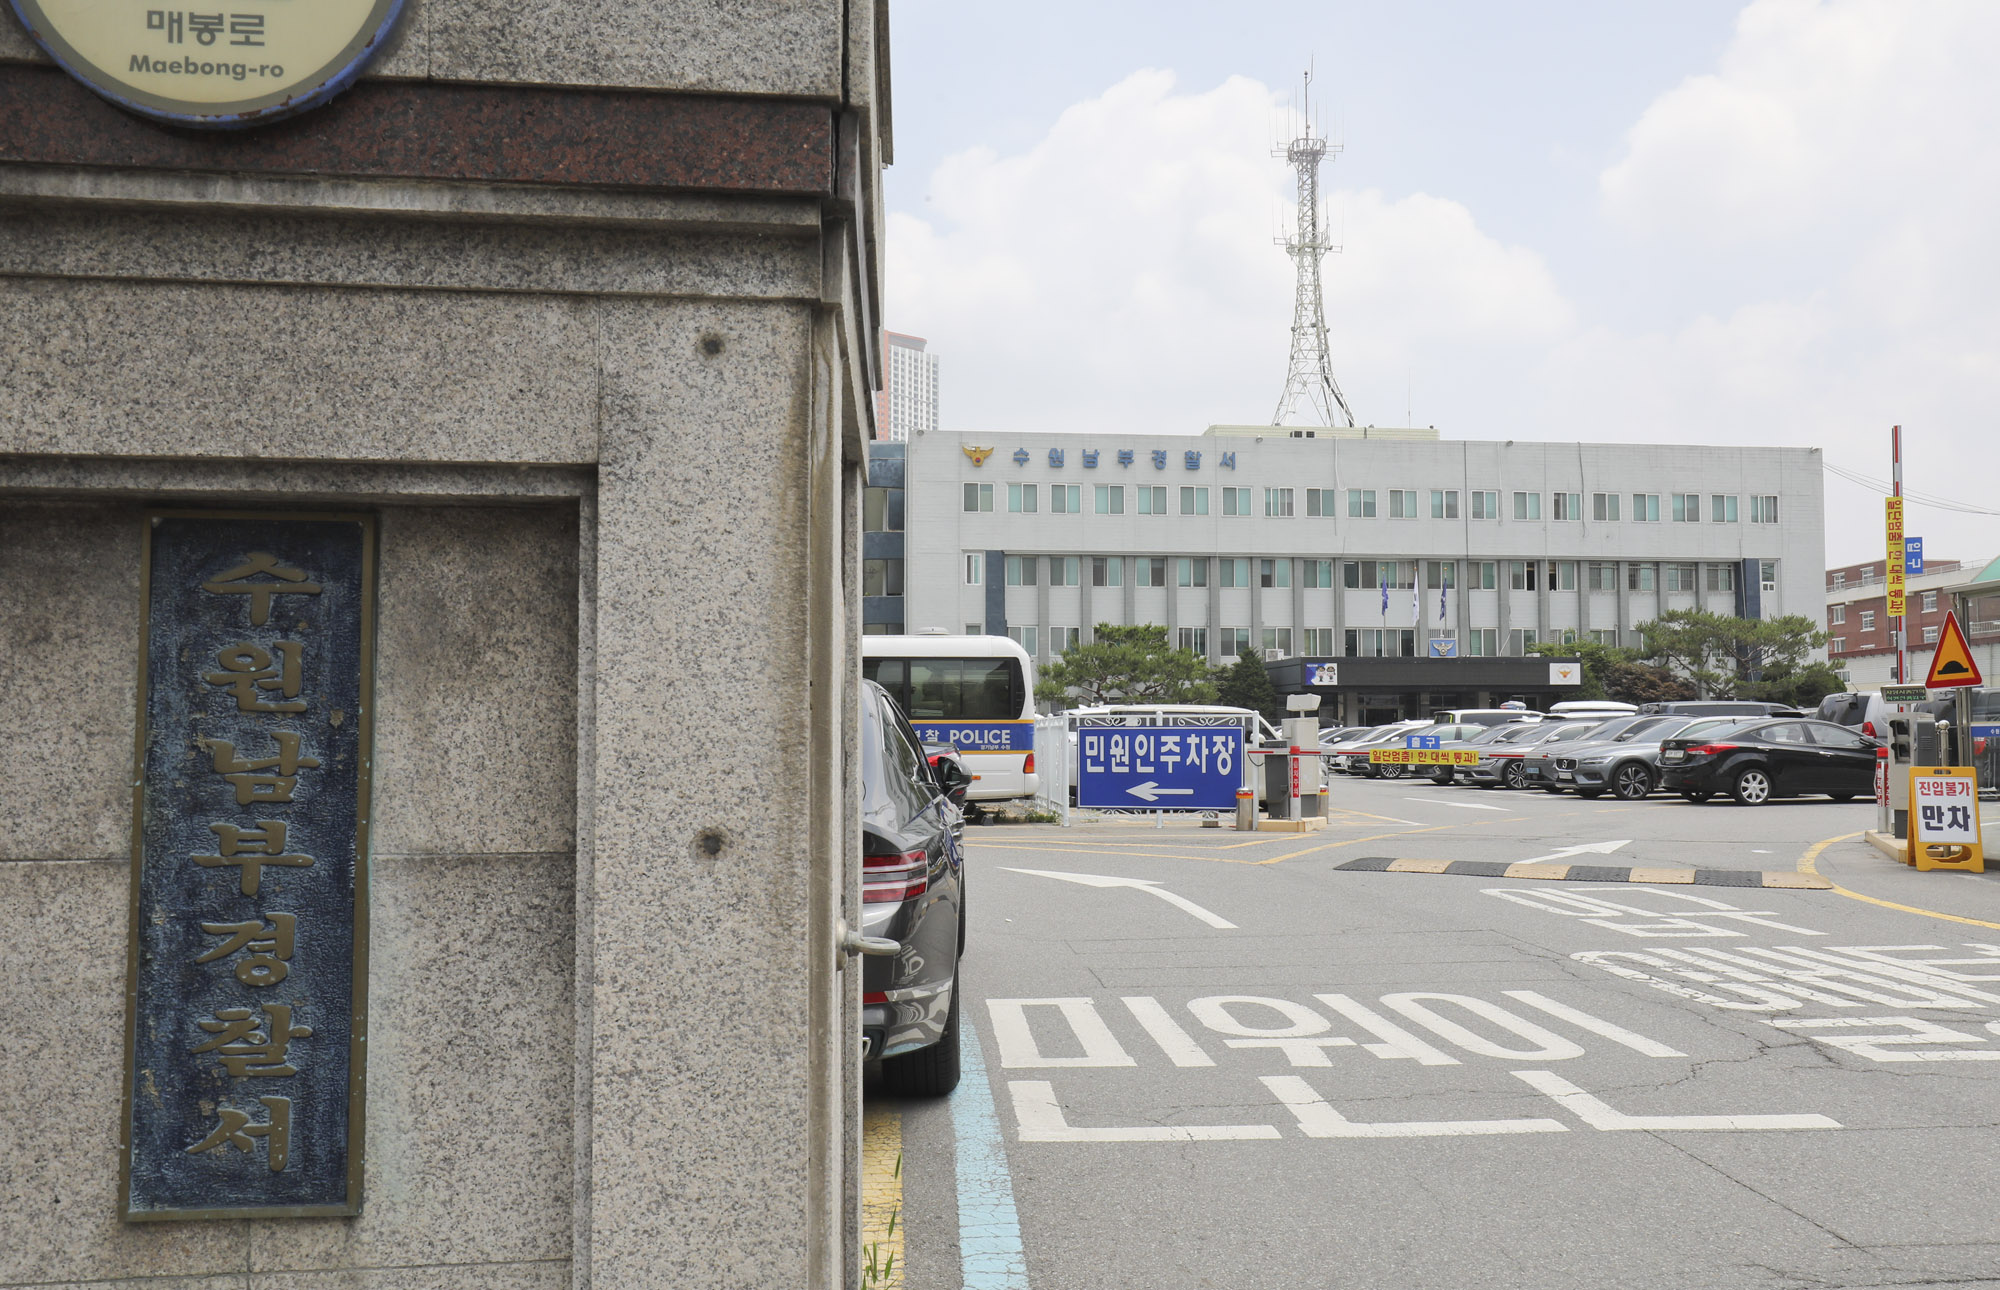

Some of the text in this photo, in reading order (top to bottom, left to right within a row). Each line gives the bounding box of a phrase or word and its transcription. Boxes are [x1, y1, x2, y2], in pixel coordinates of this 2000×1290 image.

[146, 9, 265, 47] 매봉로
[128, 54, 284, 81] Maebong-ro
[1013, 447, 1236, 471] 수원남부경찰서
[1889, 550, 1904, 560] 한
[1907, 542, 1921, 568] 입구
[1889, 564, 1903, 585] 대씩
[1888, 588, 1903, 613] 통과!
[915, 728, 1011, 744] 찰 POLICE
[1411, 737, 1436, 748] 출구
[1085, 734, 1236, 776] 민원인주차장
[1372, 750, 1477, 764] 일단멈춤! 한 대씩 통과!
[1919, 781, 1971, 797] 진입불가
[1921, 805, 1971, 832] 만차
[187, 550, 323, 1173] 수원남부경찰서
[985, 990, 1843, 1142] 민원인
